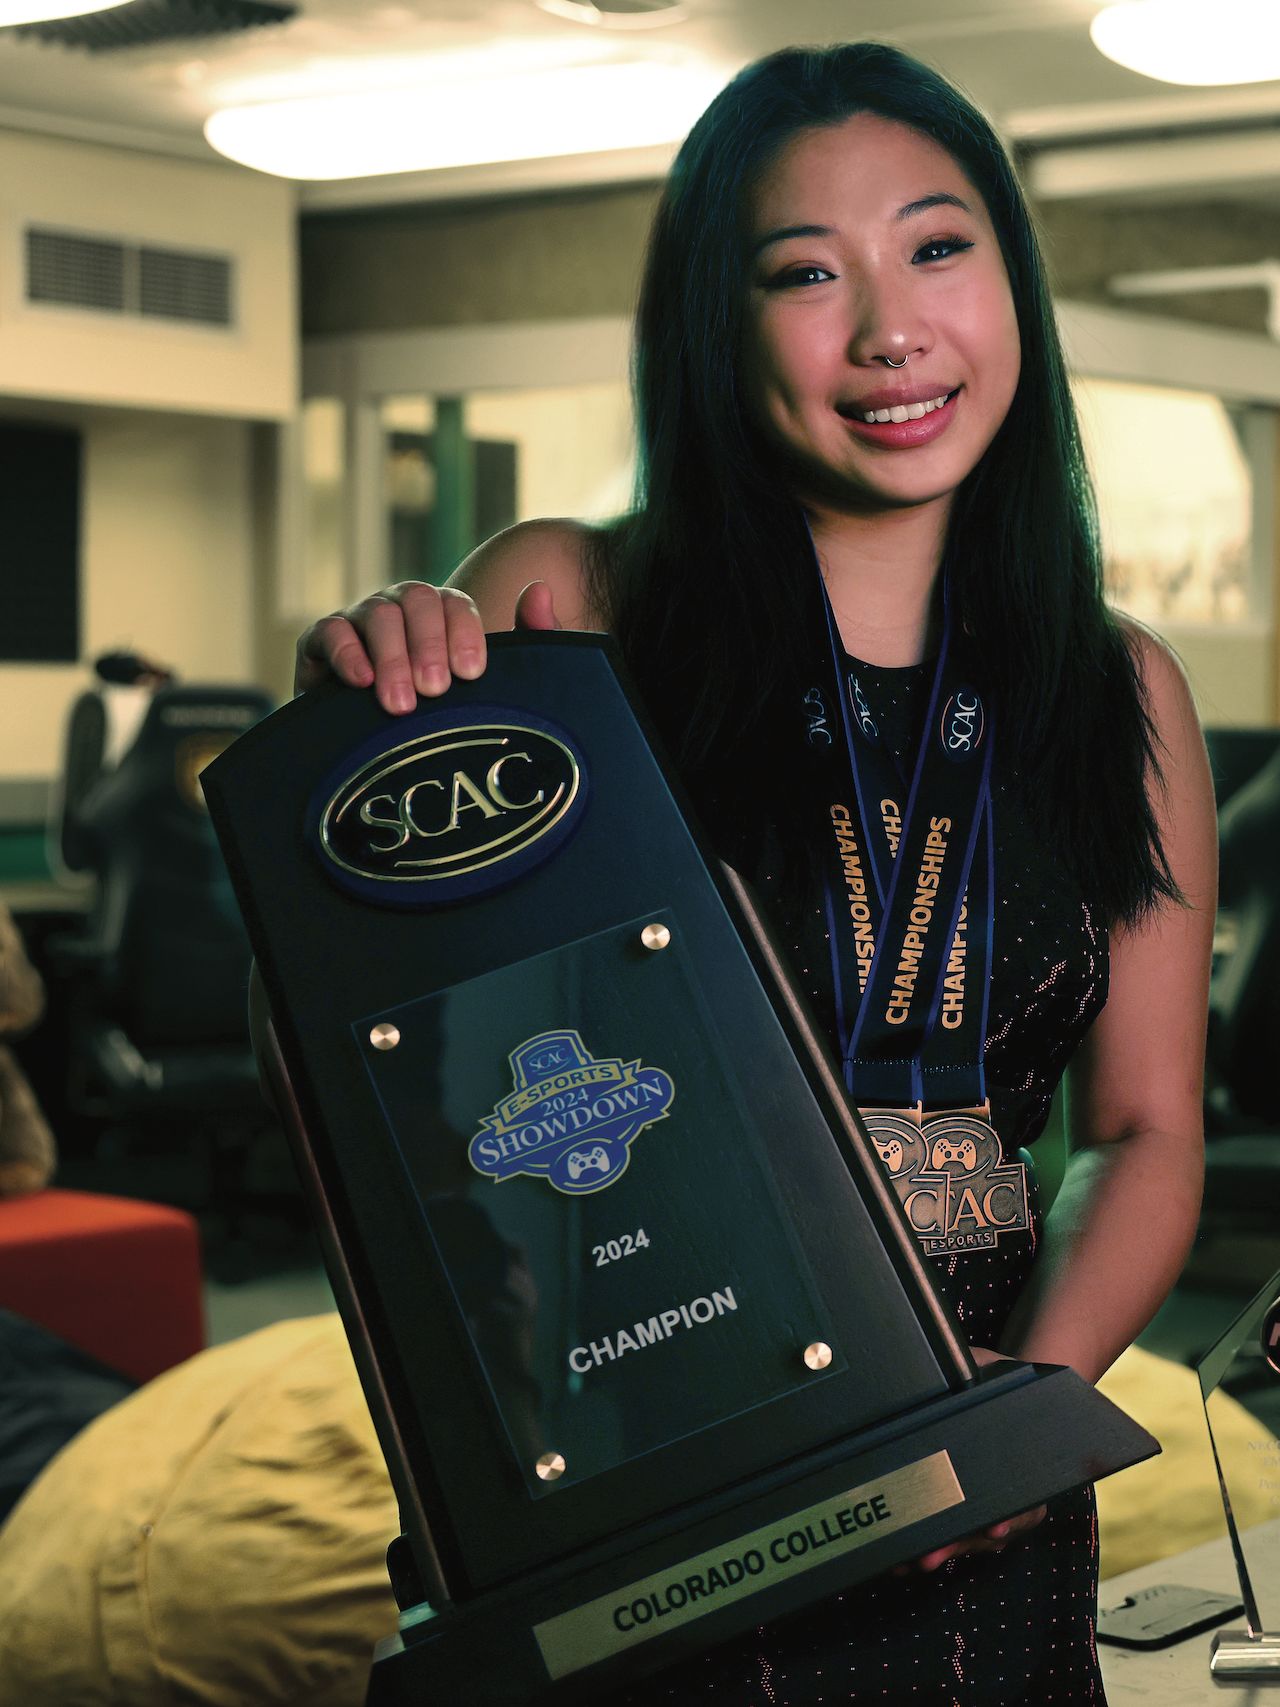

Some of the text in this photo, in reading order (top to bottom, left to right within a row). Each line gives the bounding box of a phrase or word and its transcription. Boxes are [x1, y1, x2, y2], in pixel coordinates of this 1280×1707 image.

[948, 692, 978, 751] SCAC
[359, 752, 544, 853] SCAC
[885, 815, 952, 1025] CHAMPIONSHIPS
[528, 1048, 569, 1070] SCAC
[508, 1066, 613, 1116] E-SPORTS
[540, 1087, 590, 1117] 2024
[478, 1077, 665, 1166] SHOWDOWN
[591, 1227, 651, 1267] 2024
[930, 1232, 992, 1250] ESPORTS
[568, 1286, 739, 1373] CHAMPION
[612, 1494, 892, 1633] COLORADO COLLEGE
